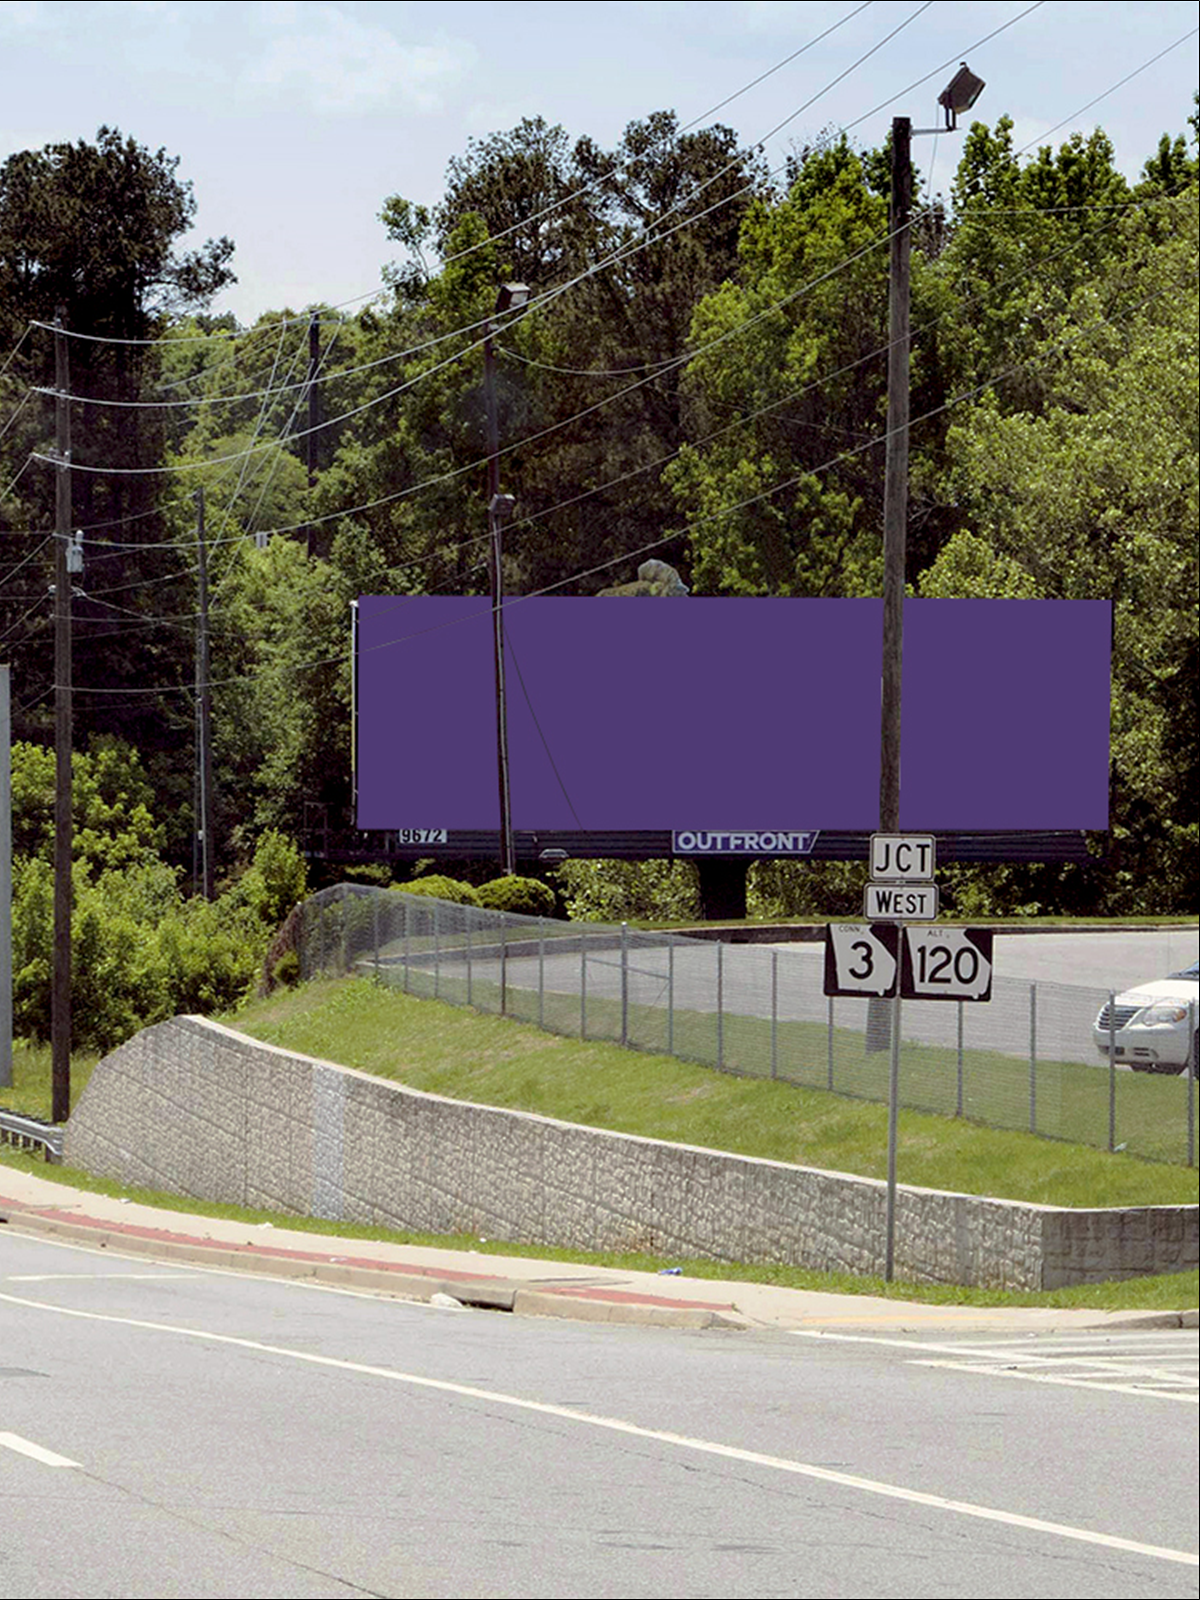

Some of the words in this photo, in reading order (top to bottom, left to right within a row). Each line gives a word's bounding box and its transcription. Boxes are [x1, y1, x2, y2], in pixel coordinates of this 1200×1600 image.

[401, 829, 443, 843] 9672
[677, 831, 811, 850] OUTFRONT
[875, 843, 930, 872] JCT
[875, 890, 927, 914] WEST
[927, 930, 944, 938] ALT
[848, 941, 874, 980] 3
[917, 945, 978, 984] 120
